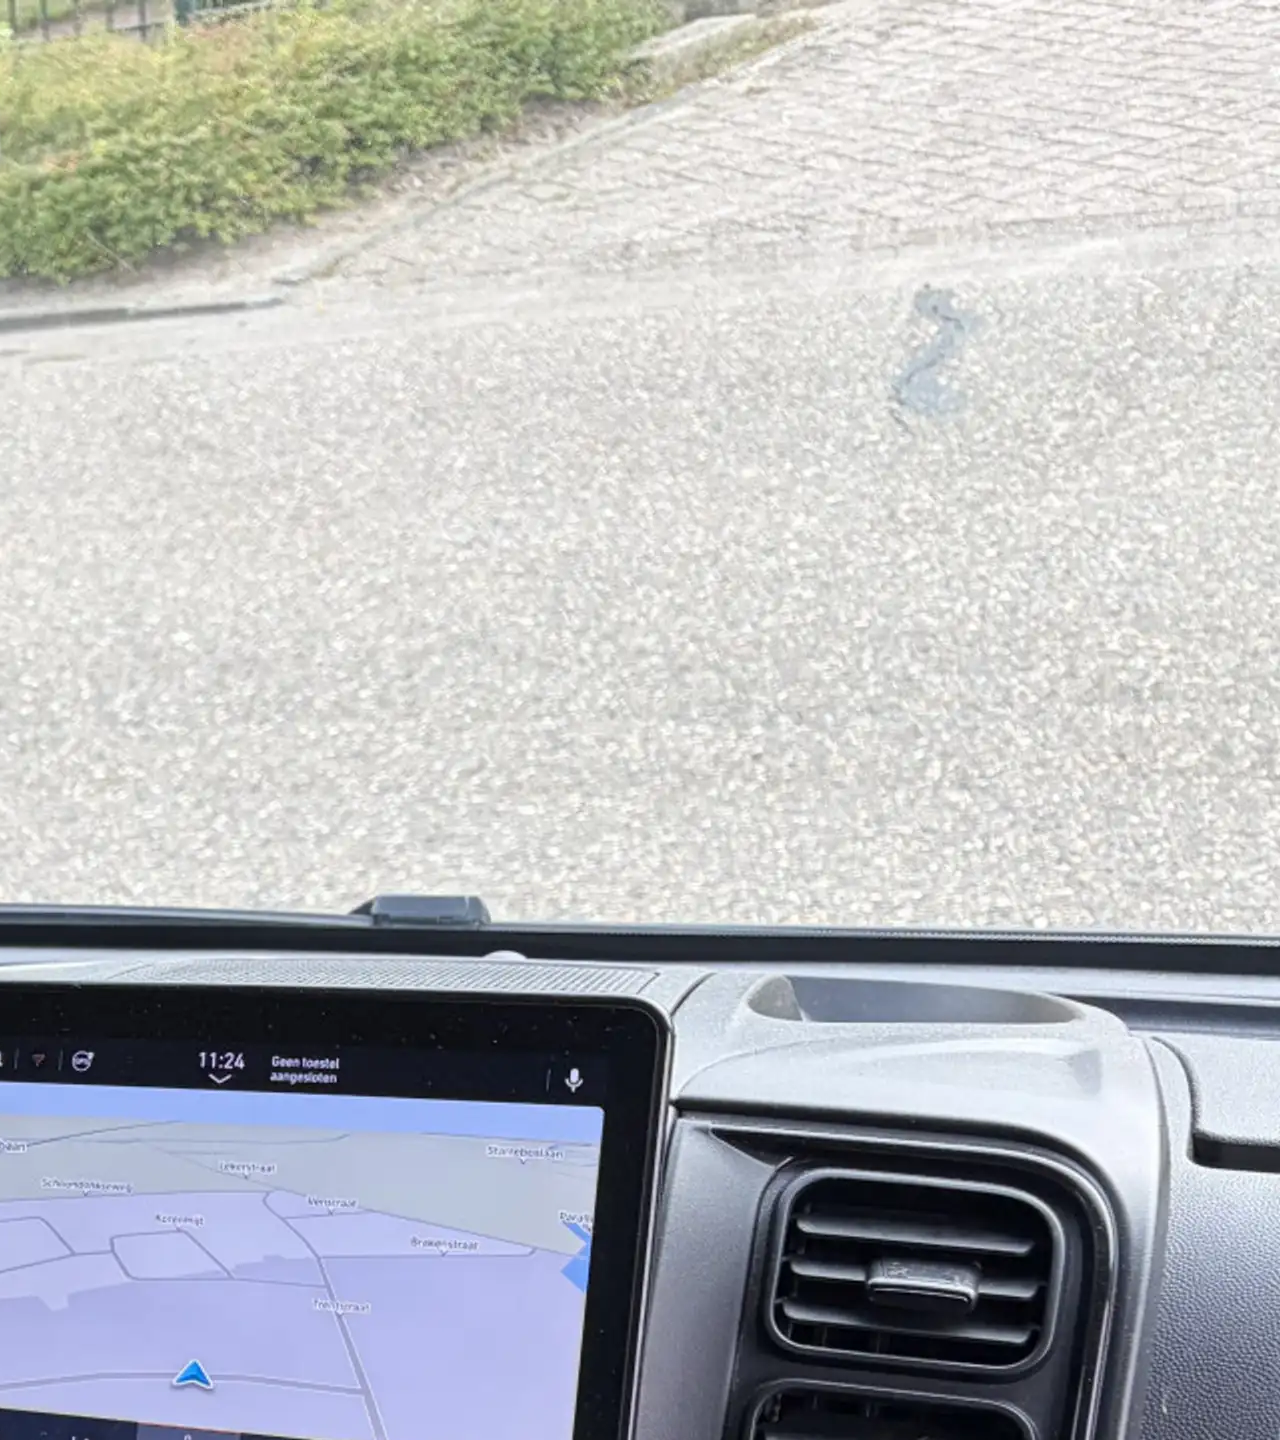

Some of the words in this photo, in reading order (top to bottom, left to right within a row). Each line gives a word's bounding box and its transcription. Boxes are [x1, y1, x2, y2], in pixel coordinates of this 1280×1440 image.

[198, 1051, 246, 1070] 11:24
[271, 1055, 300, 1069] Geen
[302, 1056, 340, 1071] toestel
[270, 1071, 338, 1087] aangesloten
